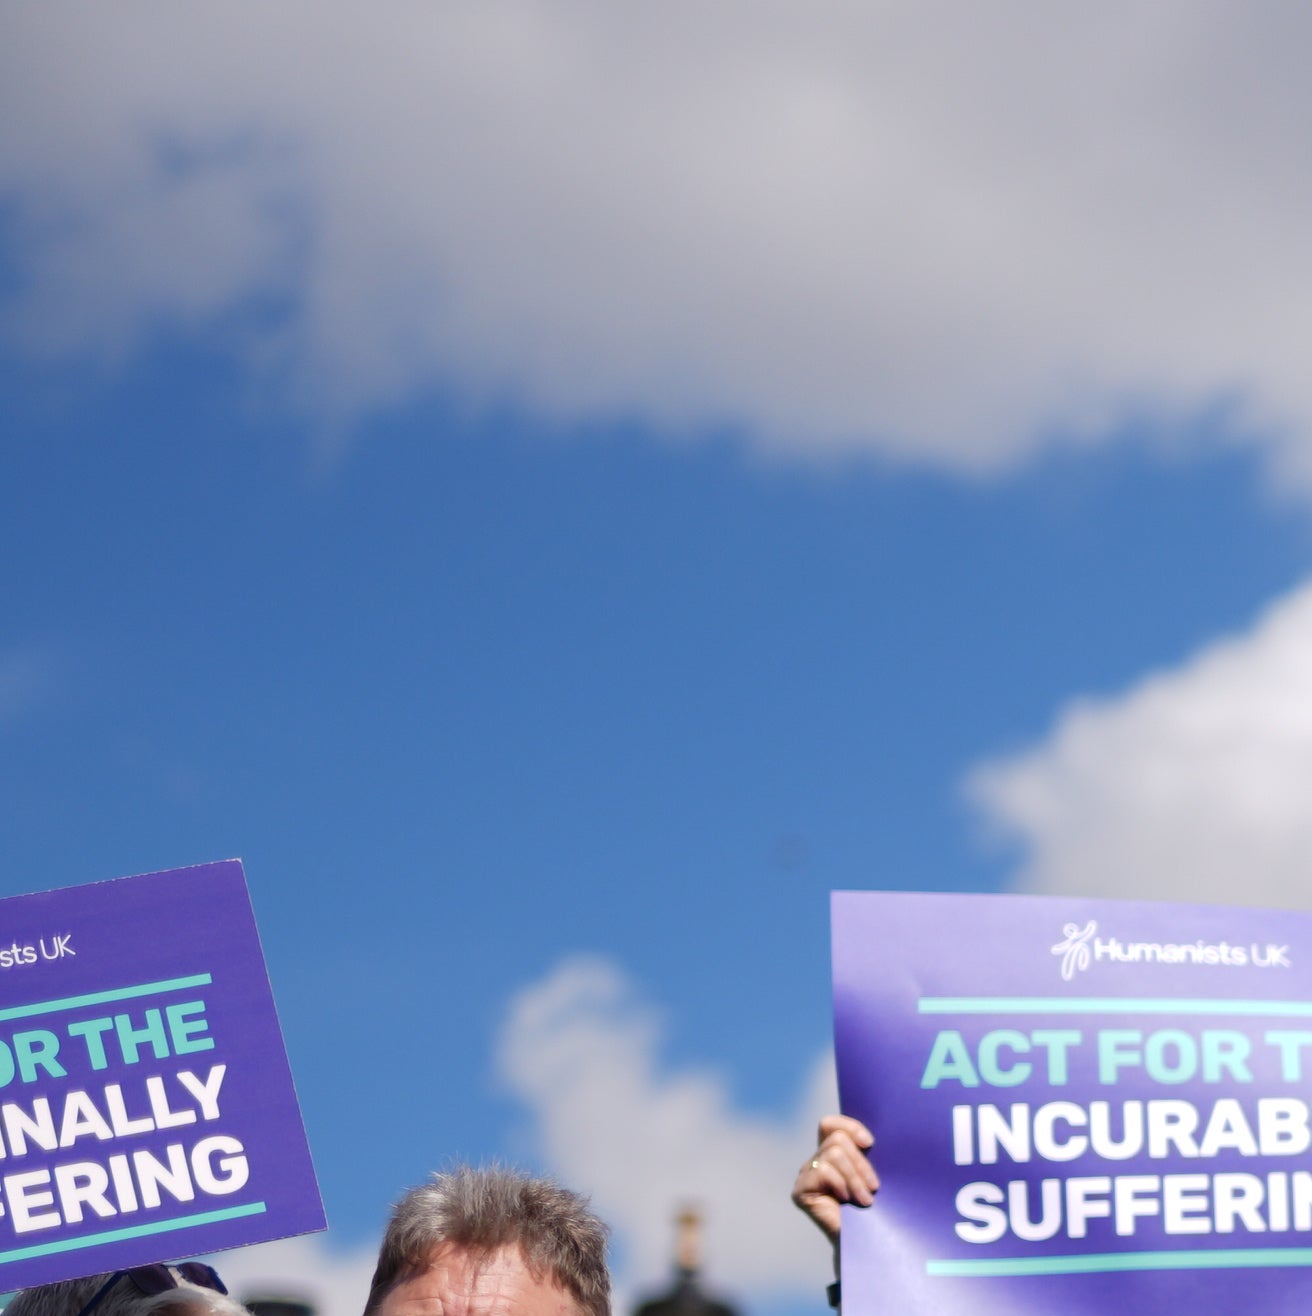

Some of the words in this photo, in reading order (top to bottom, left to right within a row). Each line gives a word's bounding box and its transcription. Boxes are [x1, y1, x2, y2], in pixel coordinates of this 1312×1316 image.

[40, 934, 76, 960] UK
[1094, 935, 1248, 968] Humanists
[1250, 941, 1292, 969] UK
[68, 1000, 215, 1071] THE
[920, 1030, 1081, 1090] ACT
[1099, 1028, 1252, 1087] FOR
[0, 1064, 227, 1158] NALLY
[0, 1135, 250, 1234] ERING
